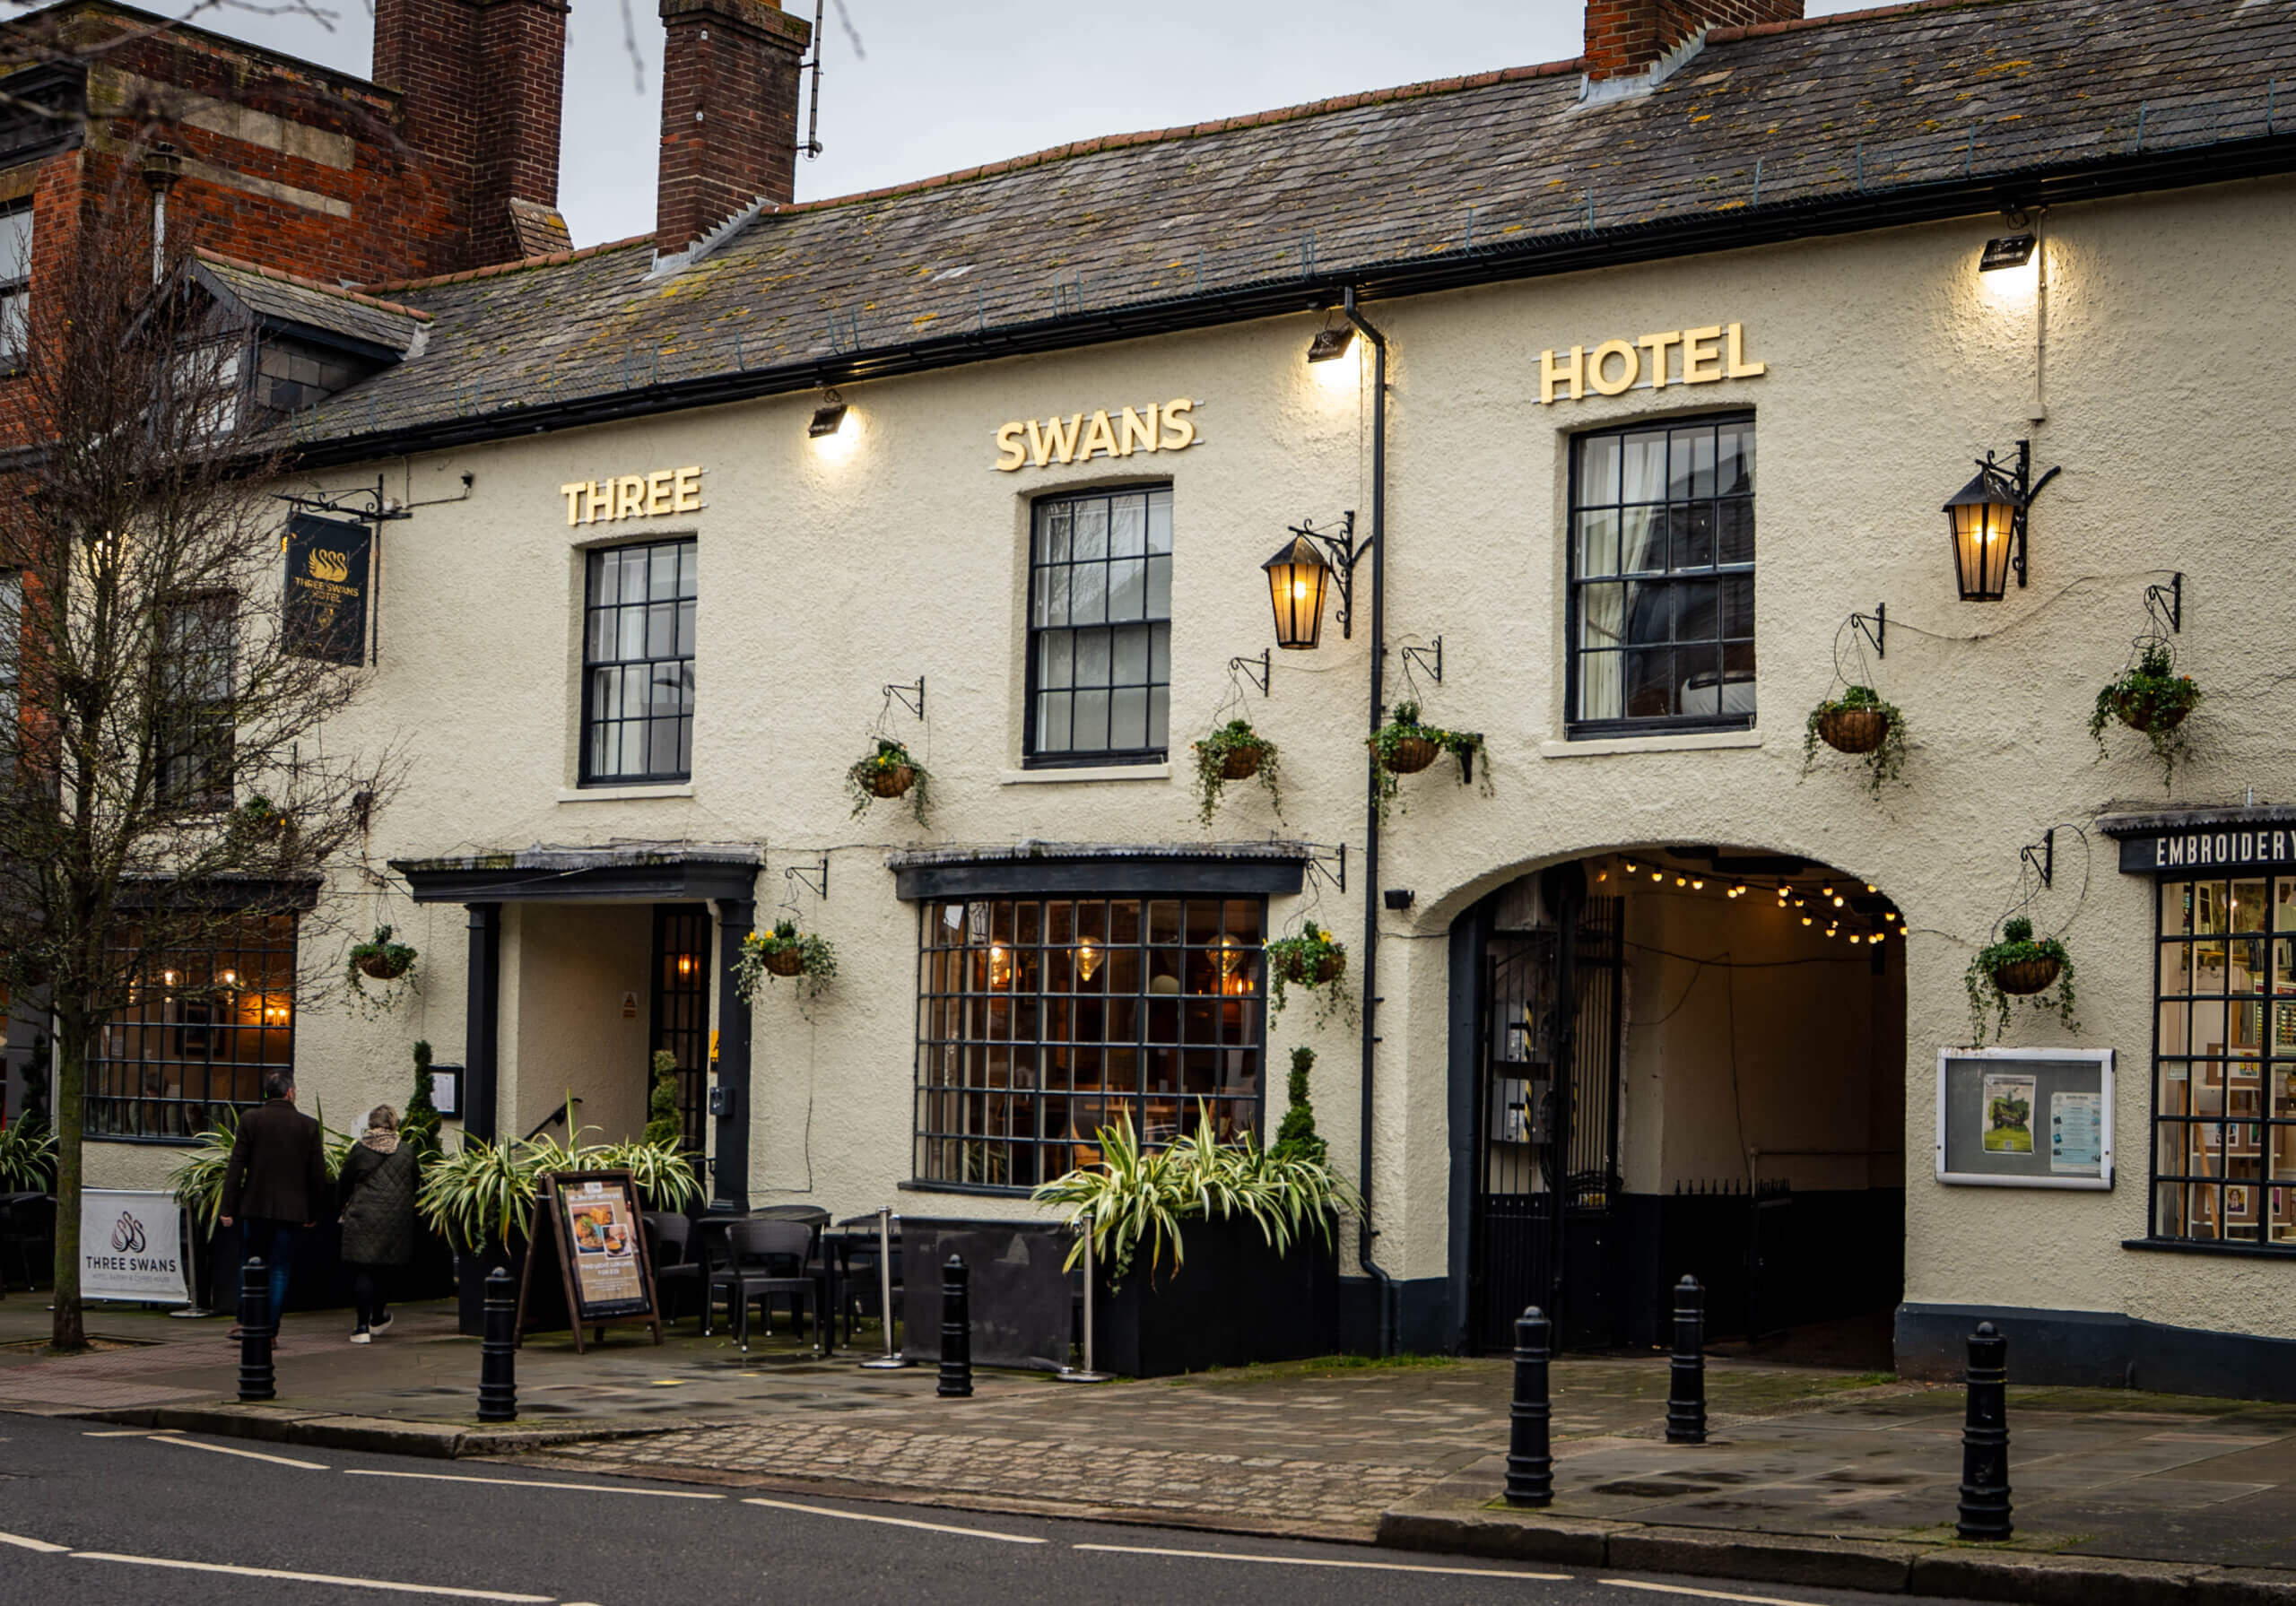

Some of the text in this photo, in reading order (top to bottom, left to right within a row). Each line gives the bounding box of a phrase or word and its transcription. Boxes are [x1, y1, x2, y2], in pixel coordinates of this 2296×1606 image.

[561, 322, 1766, 525] THREE SWANS HOTEL
[294, 577, 359, 597] THREE SWANS
[86, 1256, 176, 1272] THREE SWANS
